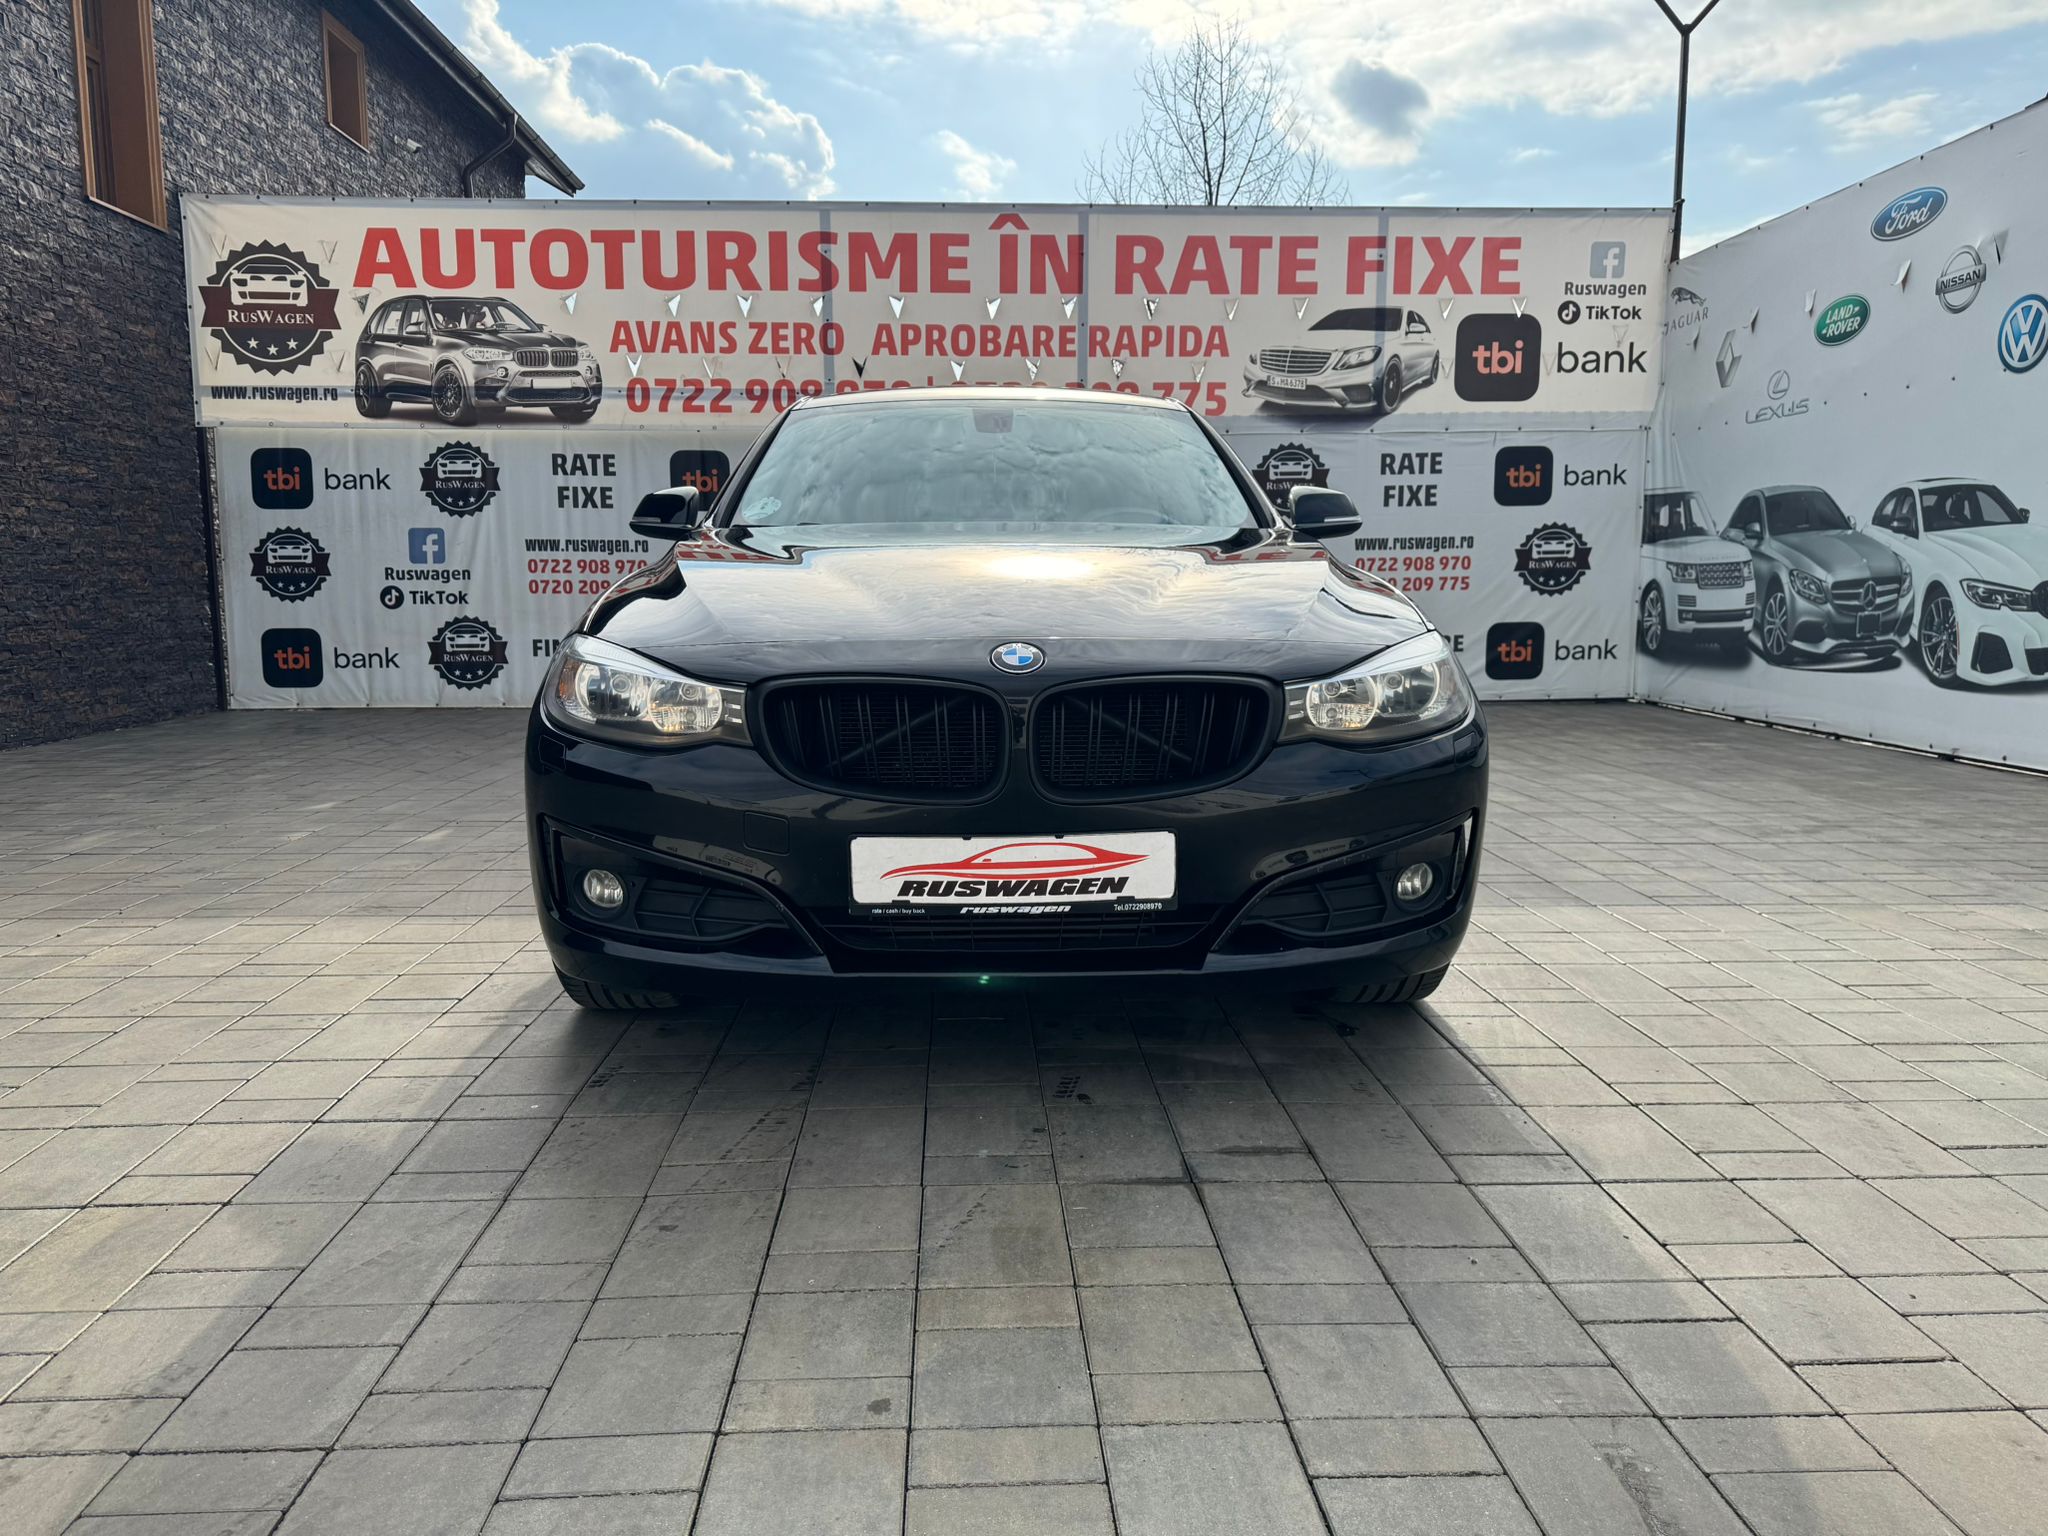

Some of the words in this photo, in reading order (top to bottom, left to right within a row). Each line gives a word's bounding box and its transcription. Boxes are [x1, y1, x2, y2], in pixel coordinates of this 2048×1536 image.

[1884, 195, 1933, 235] Ford
[352, 226, 972, 294] AUTOTURISME
[988, 212, 1084, 295] ÎN
[1114, 235, 1319, 295] RATE
[1346, 236, 1522, 295] FIXE
[1564, 281, 1647, 298] Ruswagen
[1940, 268, 1981, 290] NISSAN
[1585, 304, 1642, 321] TikTok
[1663, 306, 1708, 336] JAGUAR
[1826, 304, 1853, 324] LAND
[1826, 316, 1861, 338] ROVER
[609, 321, 738, 355] AVANS
[748, 322, 844, 356] ZERO
[871, 323, 1077, 358] APROBARE
[1089, 325, 1230, 358] RAPIDA
[1472, 339, 1524, 375] tbi
[1557, 341, 1647, 374] bank
[211, 385, 338, 403] www.ruswagen.ro
[626, 377, 733, 414] 0722
[1745, 398, 1809, 424] LEXUS
[552, 453, 616, 476] RATE
[1380, 452, 1443, 475] RATE
[264, 466, 300, 490] tbi
[324, 467, 391, 490] bank
[1506, 463, 1541, 488] tbi
[1563, 463, 1627, 486] bank
[557, 486, 613, 509] FIXE
[1383, 484, 1438, 507] FIXE
[525, 538, 649, 555] www.ruswagen.ro
[1355, 536, 1474, 552] www.ruswagen.ro
[528, 559, 572, 574] 0722
[577, 559, 610, 574] 908
[1356, 557, 1398, 572] 0722
[1403, 556, 1435, 571] 908
[1440, 555, 1471, 570] 970
[384, 567, 471, 583] Ruswagen
[1402, 576, 1434, 591] 209
[1439, 575, 1470, 590] 775
[409, 590, 469, 605] TikTok
[529, 579, 573, 594] 0720
[274, 646, 310, 669] tbi
[334, 647, 400, 669] bank
[1497, 639, 1533, 662] tbi
[1554, 638, 1618, 661] bank
[897, 876, 1129, 898] RUSWAGEN
[960, 905, 1071, 915] ruswagen
